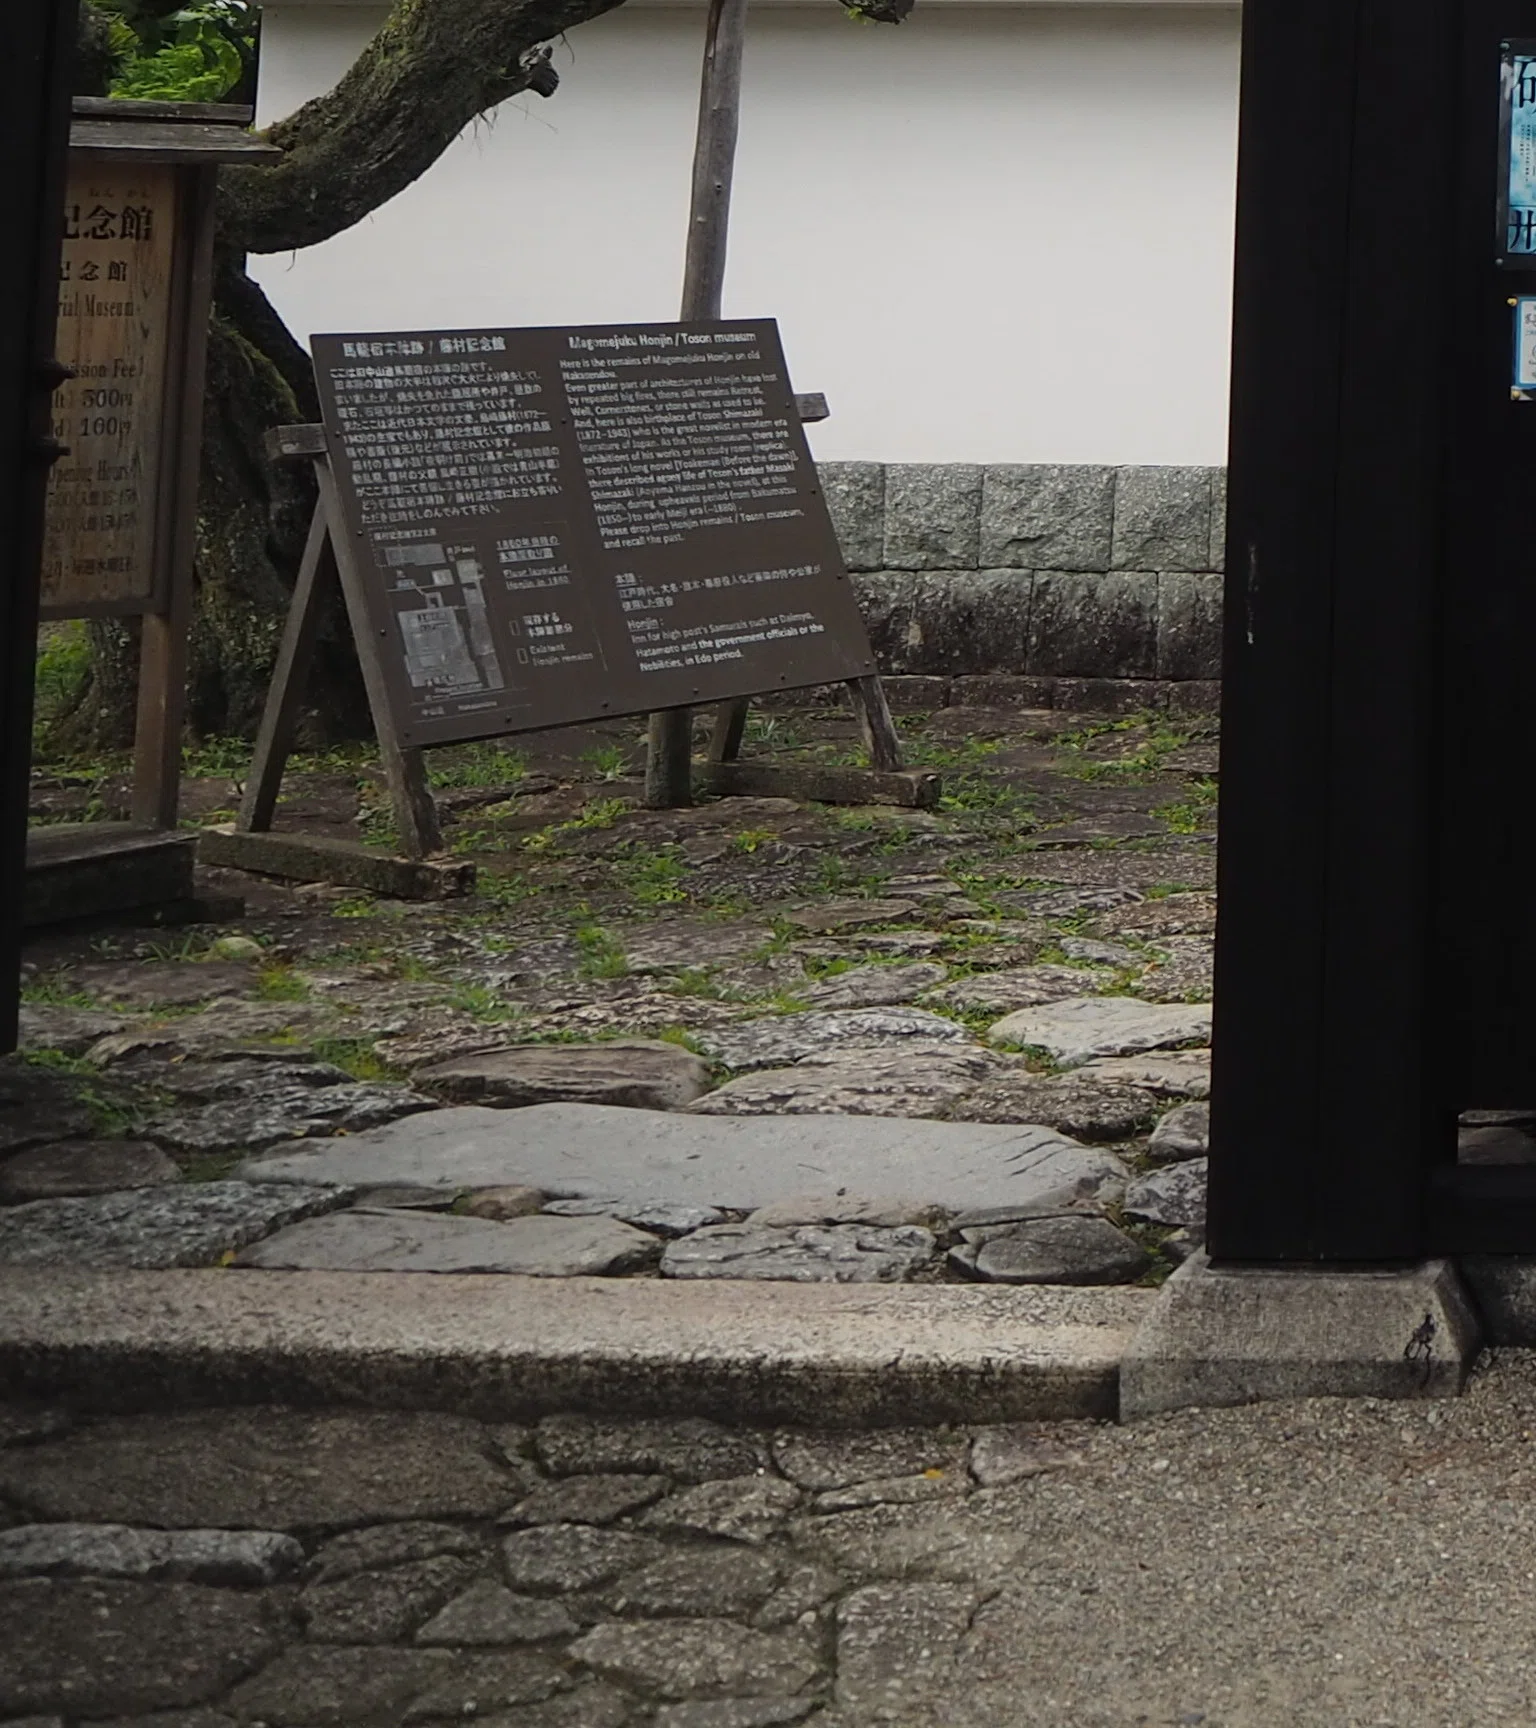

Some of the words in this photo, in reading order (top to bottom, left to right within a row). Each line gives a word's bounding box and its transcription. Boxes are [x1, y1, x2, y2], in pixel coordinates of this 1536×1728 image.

[637, 332, 675, 349] Honjin
[679, 331, 713, 344] Toson
[712, 332, 757, 343] museum
